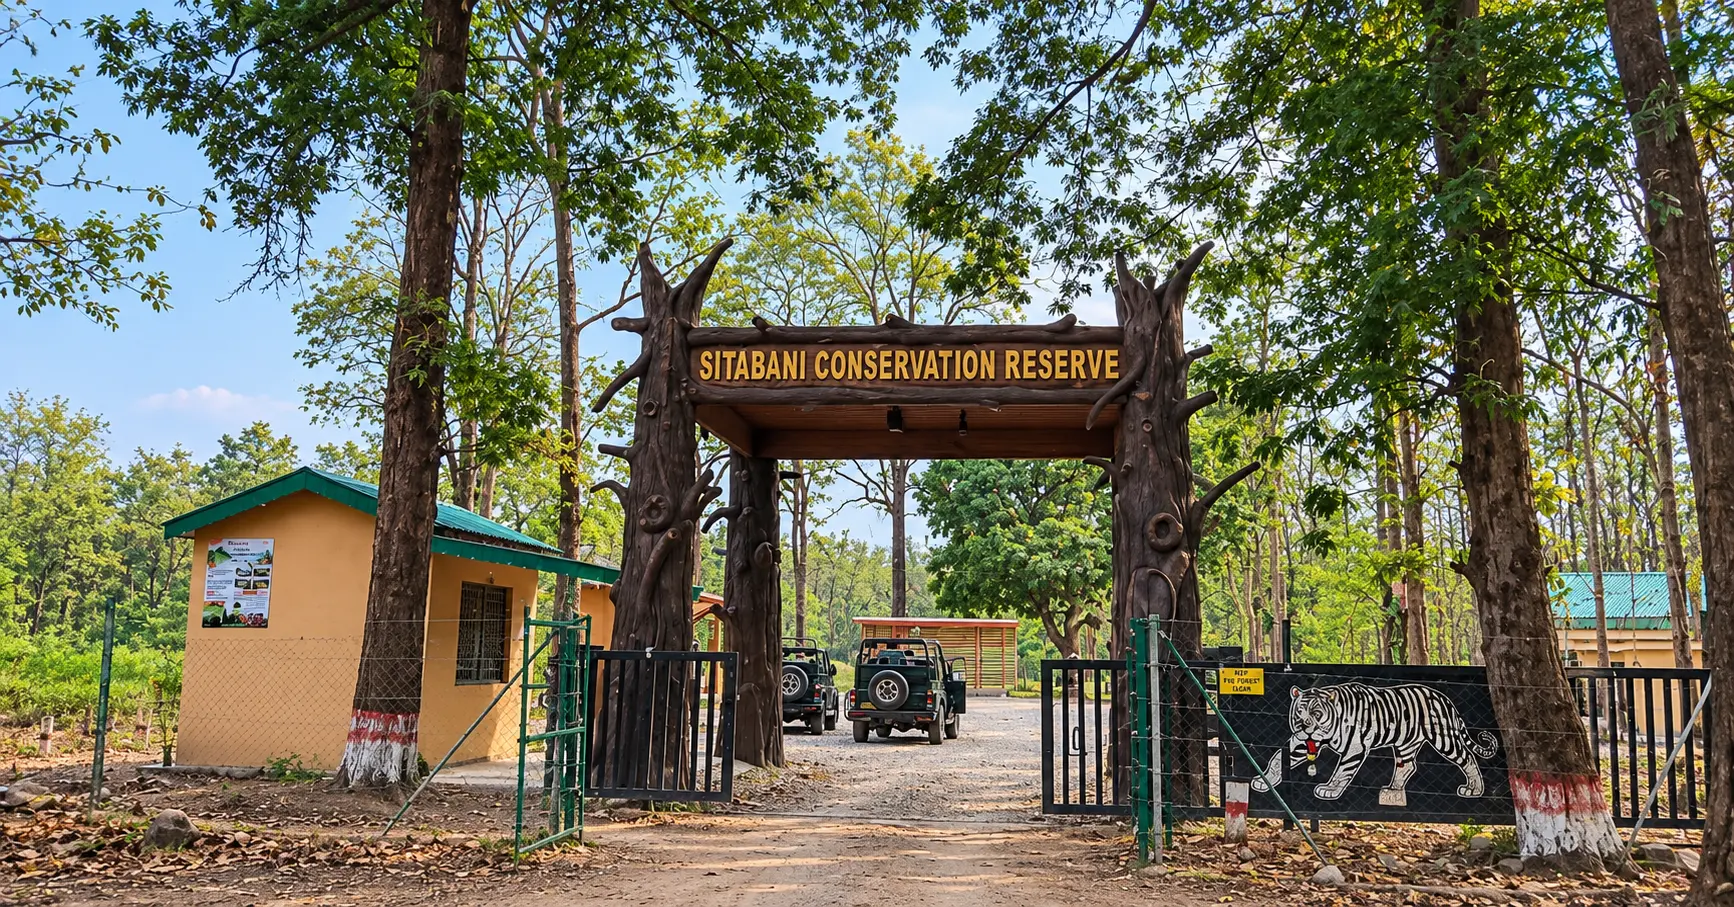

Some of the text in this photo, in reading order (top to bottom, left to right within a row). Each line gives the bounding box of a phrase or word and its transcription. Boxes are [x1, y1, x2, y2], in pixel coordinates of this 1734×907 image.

[700, 350, 1119, 380] SITABANI CONSERVATION RESERVE
